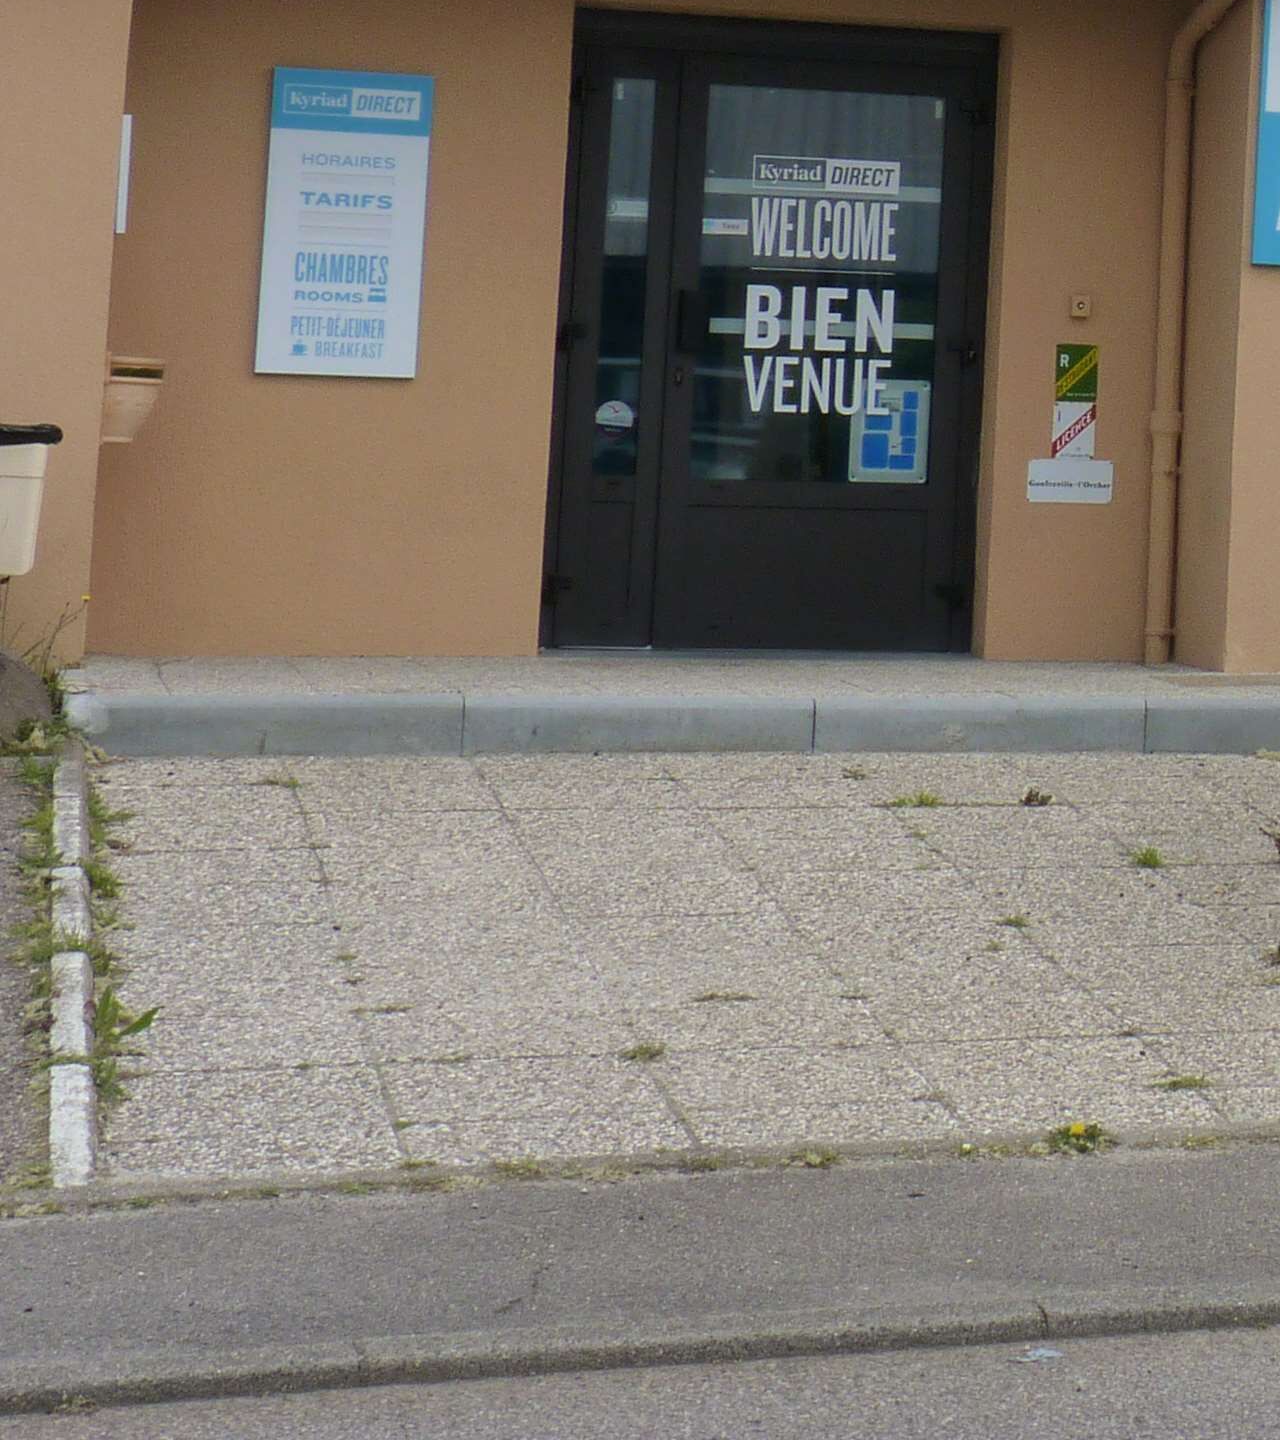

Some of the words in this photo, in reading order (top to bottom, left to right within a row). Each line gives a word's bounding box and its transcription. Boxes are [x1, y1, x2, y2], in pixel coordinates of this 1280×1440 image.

[290, 91, 347, 110] Kyriad
[355, 94, 416, 113] DIRECT
[302, 152, 396, 169] HORAIRES
[760, 164, 822, 183] Kyriad
[831, 166, 895, 187] DIRECT
[300, 192, 393, 209] TARIFS
[751, 197, 899, 261] WELCOME
[295, 252, 389, 285] CHAMBRES
[294, 290, 363, 303] ROOMS
[744, 284, 895, 353] BIEN
[315, 341, 384, 359] BREAKFAST
[1060, 353, 1070, 368] R
[743, 355, 892, 416] VENUE
[1056, 410, 1093, 451] LICENCE
